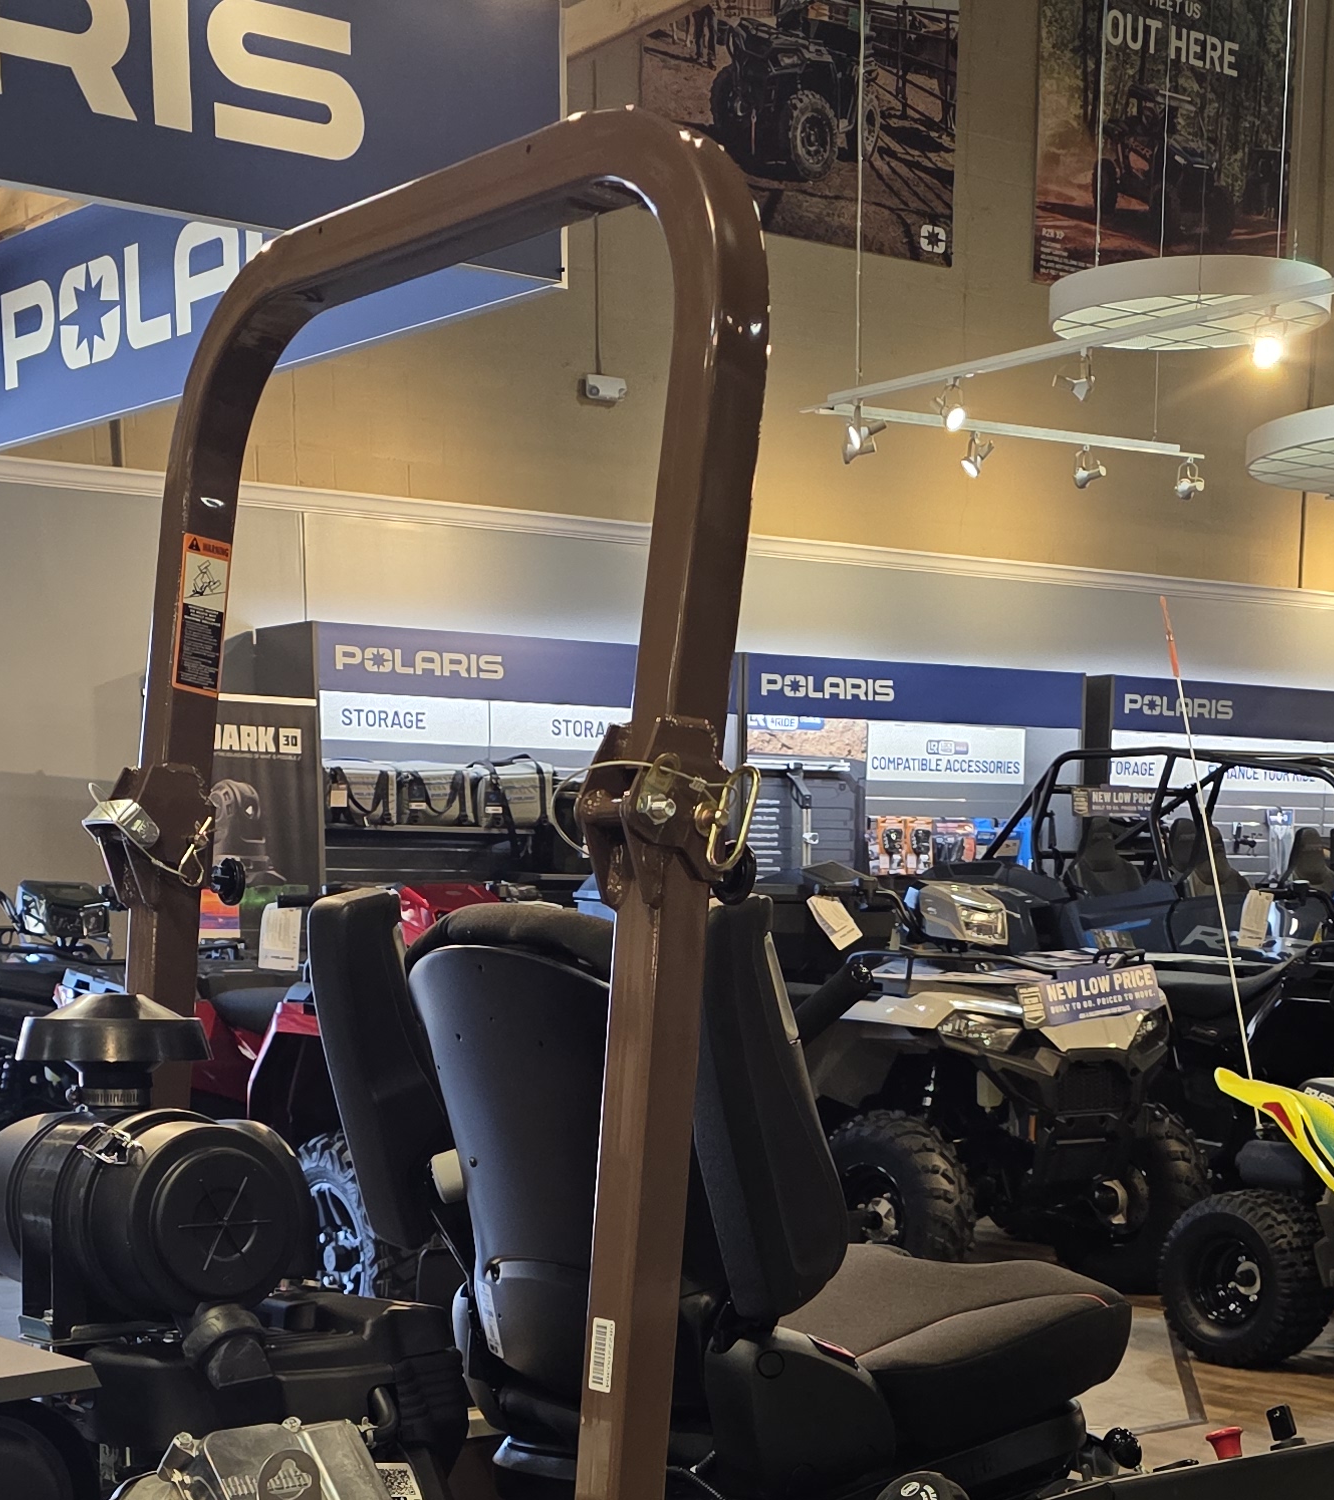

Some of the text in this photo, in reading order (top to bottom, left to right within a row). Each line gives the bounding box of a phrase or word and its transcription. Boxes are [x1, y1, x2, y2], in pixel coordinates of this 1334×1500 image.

[1185, 1, 1202, 19] US
[1107, 9, 1240, 77] OUT HERE
[1, 221, 263, 390] POLA
[335, 644, 504, 680] POLARIS
[761, 672, 895, 702] POLARIS
[341, 708, 427, 730] STORAGE
[1124, 693, 1234, 720] POLARIS
[214, 723, 298, 753] ARK 30
[551, 719, 606, 739] STORA
[871, 756, 1021, 775] COMPATIBLE ACCESSORIES
[1109, 760, 1156, 777] TORAGE
[1092, 791, 1111, 803] NEW
[1113, 792, 1131, 803] LOW
[1132, 792, 1156, 804] PRIC
[1046, 980, 1078, 1002] NEW
[1080, 974, 1111, 996] LOW
[1112, 968, 1154, 991] PRICE
[1050, 1001, 1071, 1015] BUILT
[1071, 1001, 1082, 1011] TO
[1124, 992, 1134, 1001] TO
